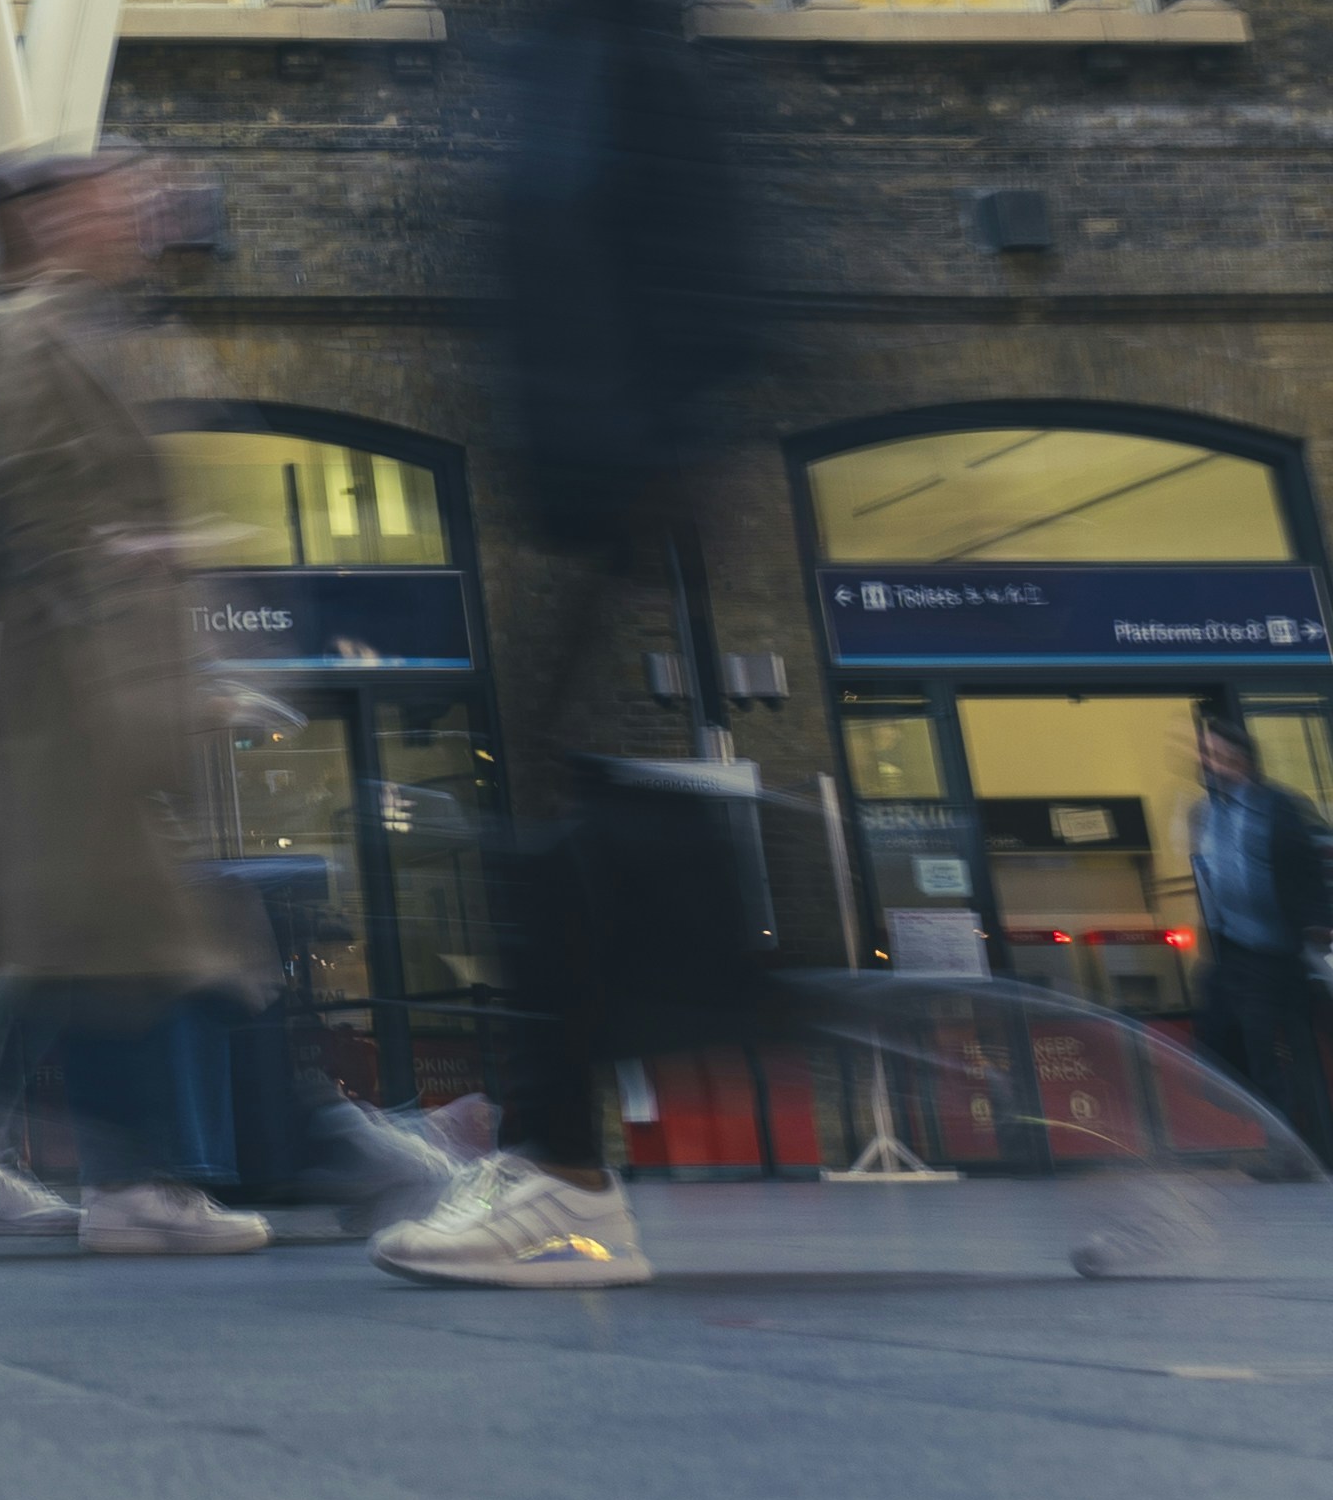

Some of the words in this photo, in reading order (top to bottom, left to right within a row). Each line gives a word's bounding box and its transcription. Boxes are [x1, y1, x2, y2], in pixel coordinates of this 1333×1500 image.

[895, 585, 964, 608] Toilets
[190, 603, 293, 632] Tickets
[1114, 620, 1203, 643] Platforms
